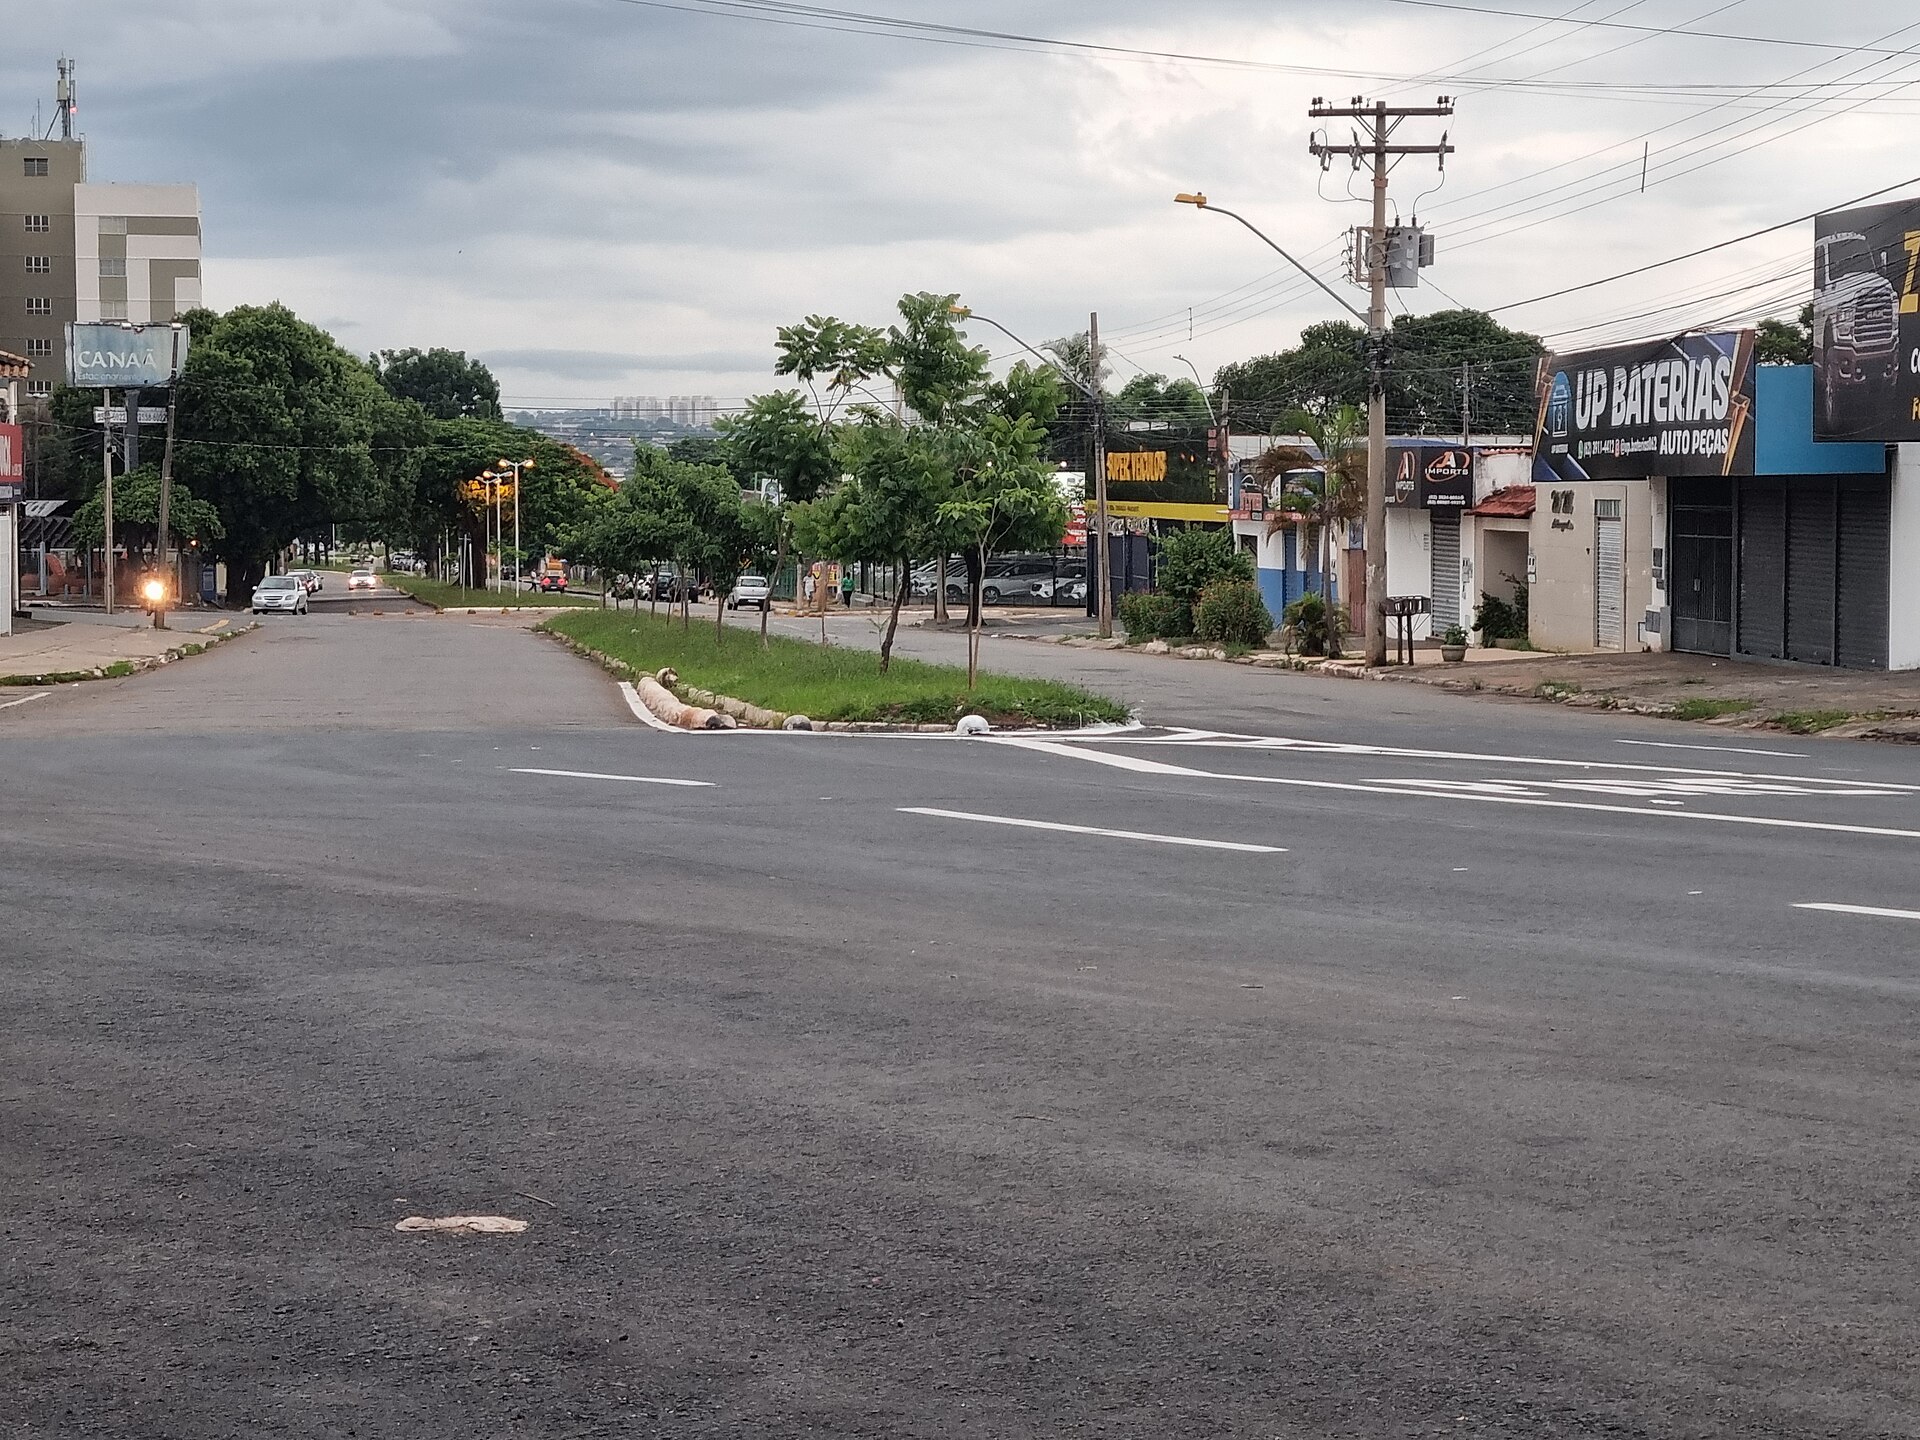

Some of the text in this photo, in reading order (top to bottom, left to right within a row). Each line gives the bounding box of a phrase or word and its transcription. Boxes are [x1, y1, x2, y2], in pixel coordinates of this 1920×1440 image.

[77, 348, 157, 369] CANAÃ
[1575, 355, 1732, 431] UP BATERIAS
[1659, 428, 1729, 458] AUTO PEÇAS
[1106, 452, 1130, 481] SUPER
[1424, 468, 1469, 476] IMPORTS
